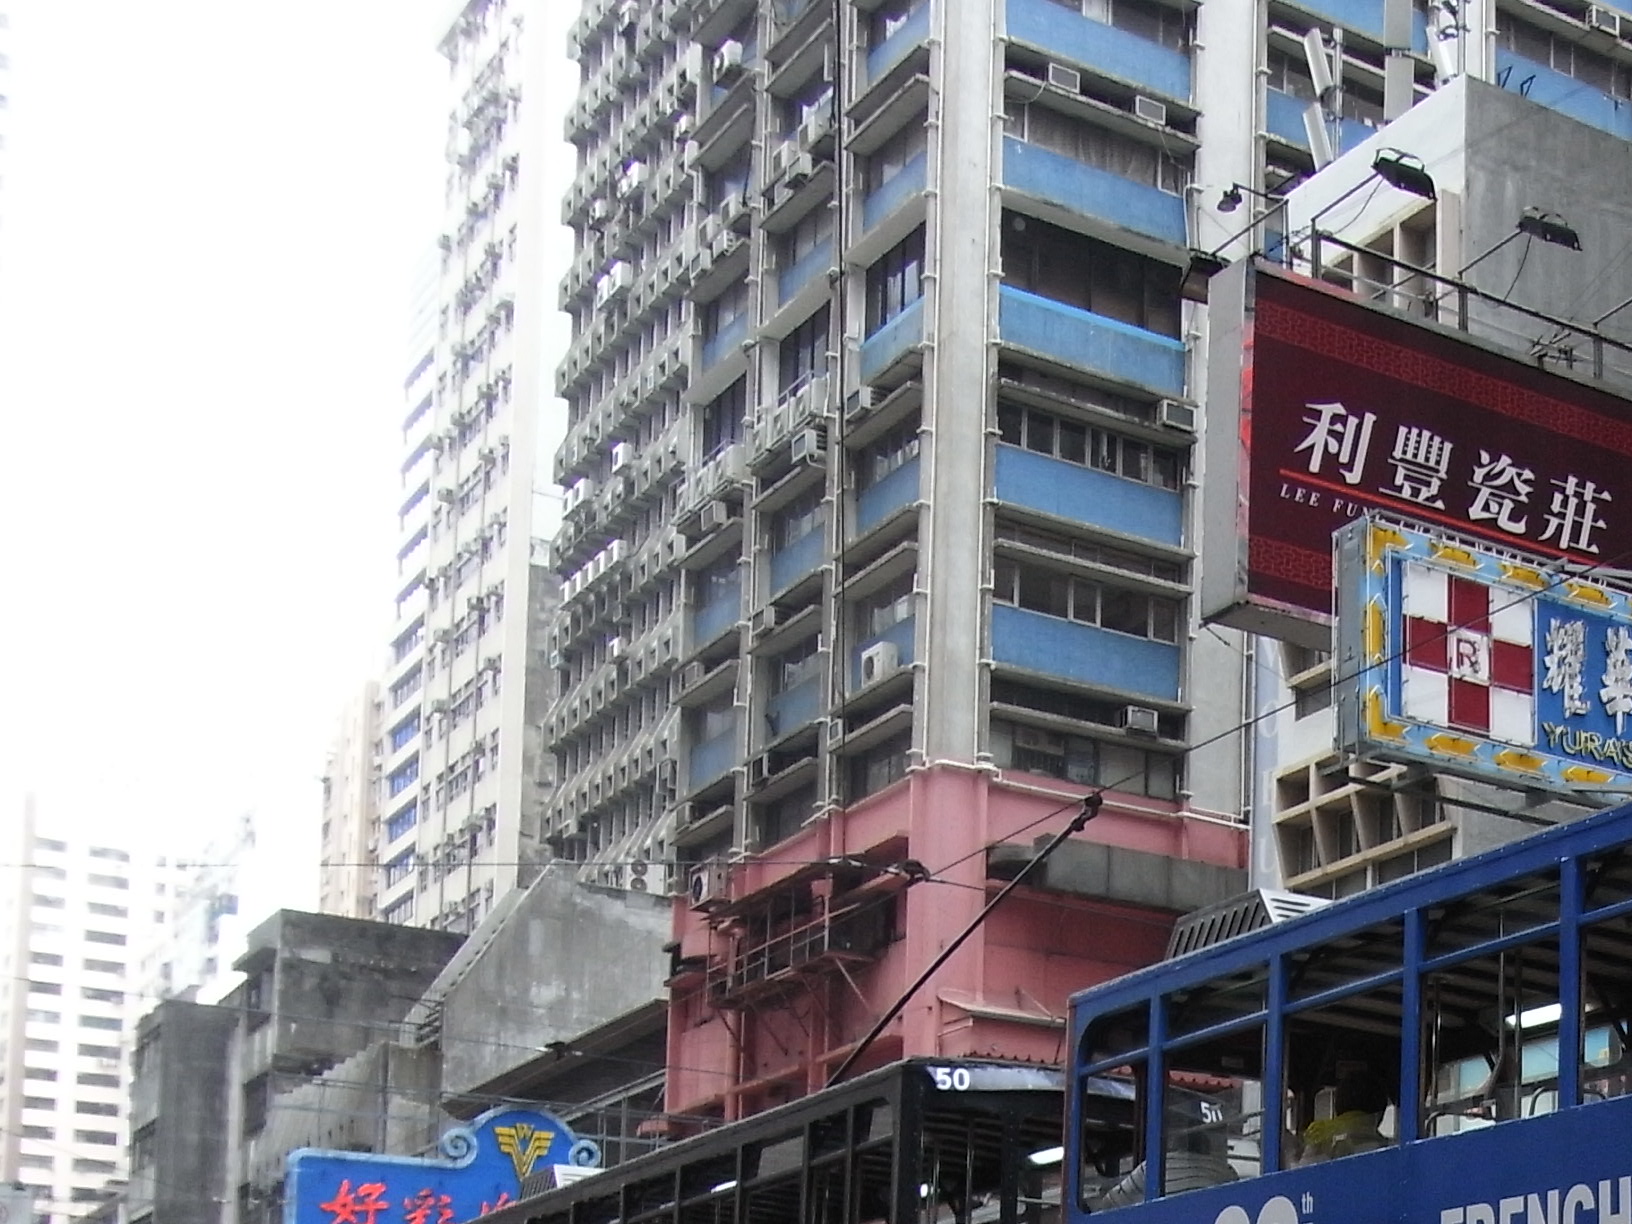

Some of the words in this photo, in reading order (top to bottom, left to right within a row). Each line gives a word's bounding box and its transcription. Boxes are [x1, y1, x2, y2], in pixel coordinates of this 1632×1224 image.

[1293, 399, 1613, 556] 利豐瓷莊
[1279, 482, 1320, 508] LEE
[934, 1066, 972, 1092] 50
